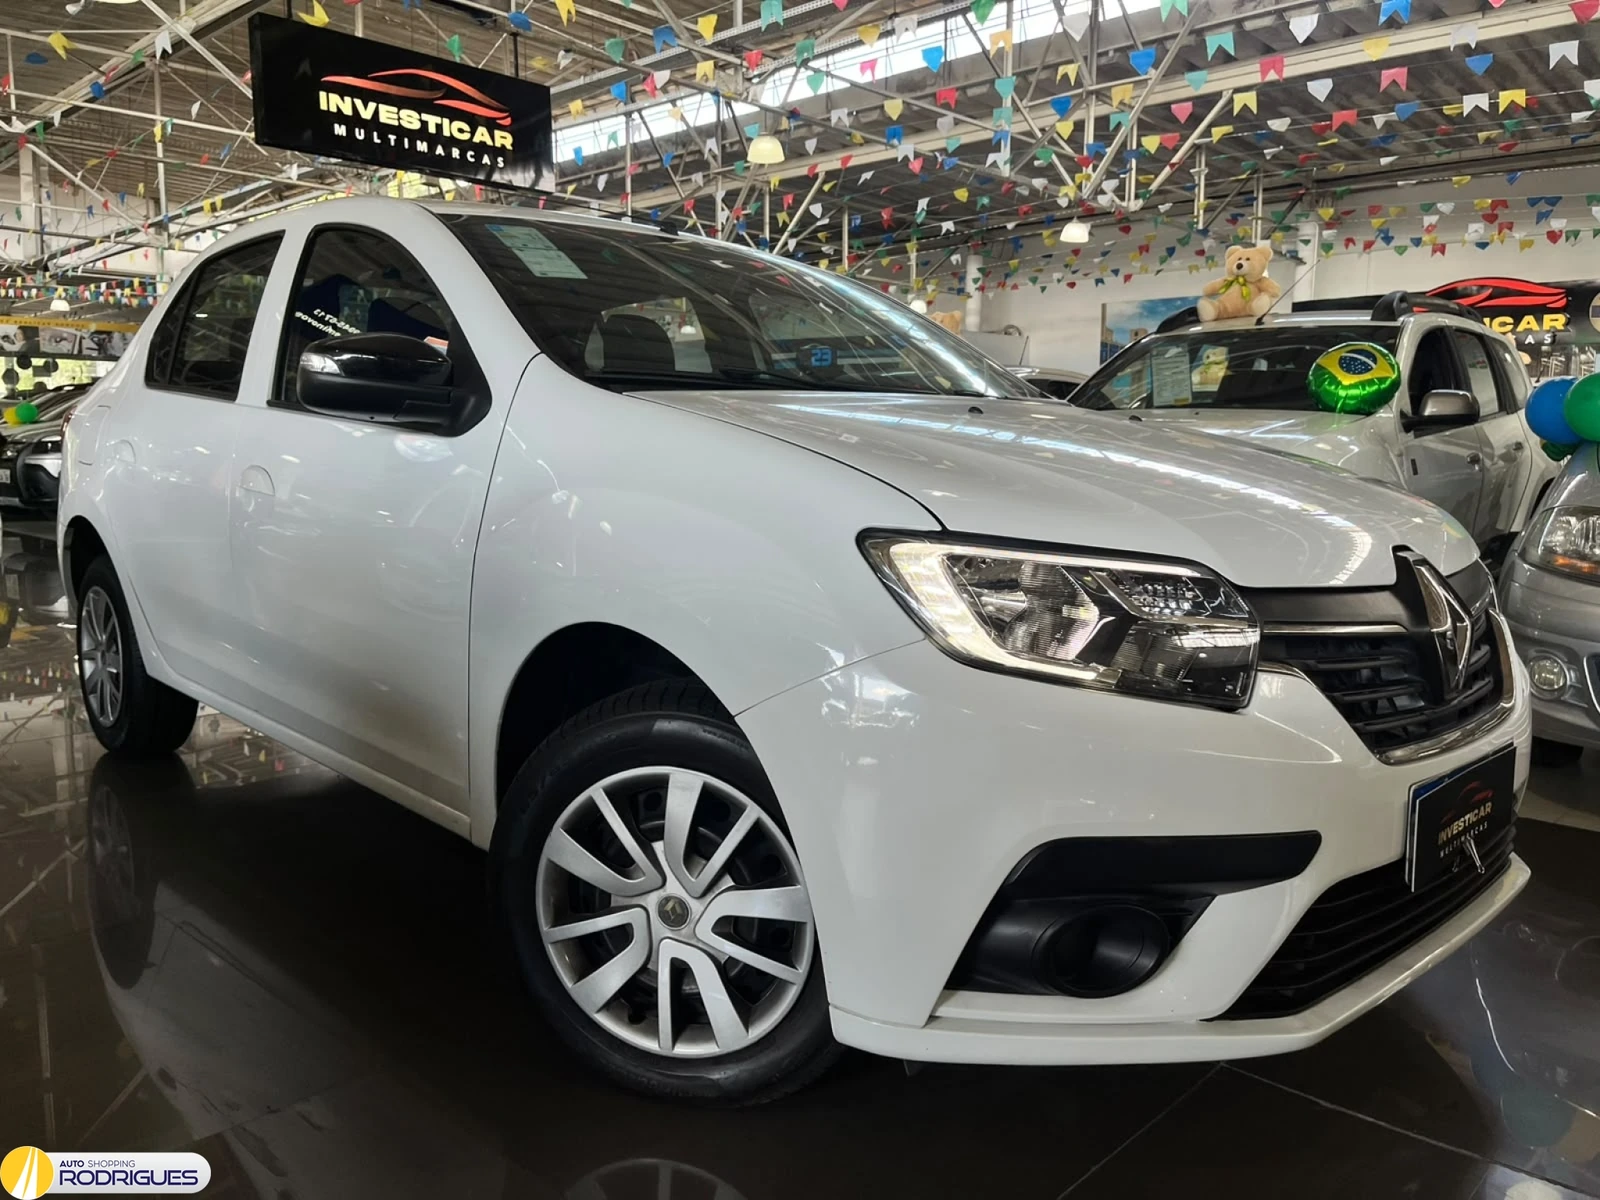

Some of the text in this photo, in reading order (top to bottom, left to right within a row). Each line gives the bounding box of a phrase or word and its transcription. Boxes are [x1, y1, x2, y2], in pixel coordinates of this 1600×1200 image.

[319, 91, 514, 150] INVESTICAR
[334, 123, 505, 169] MULTIMARCAS
[1438, 801, 1492, 846] INVESTICAR
